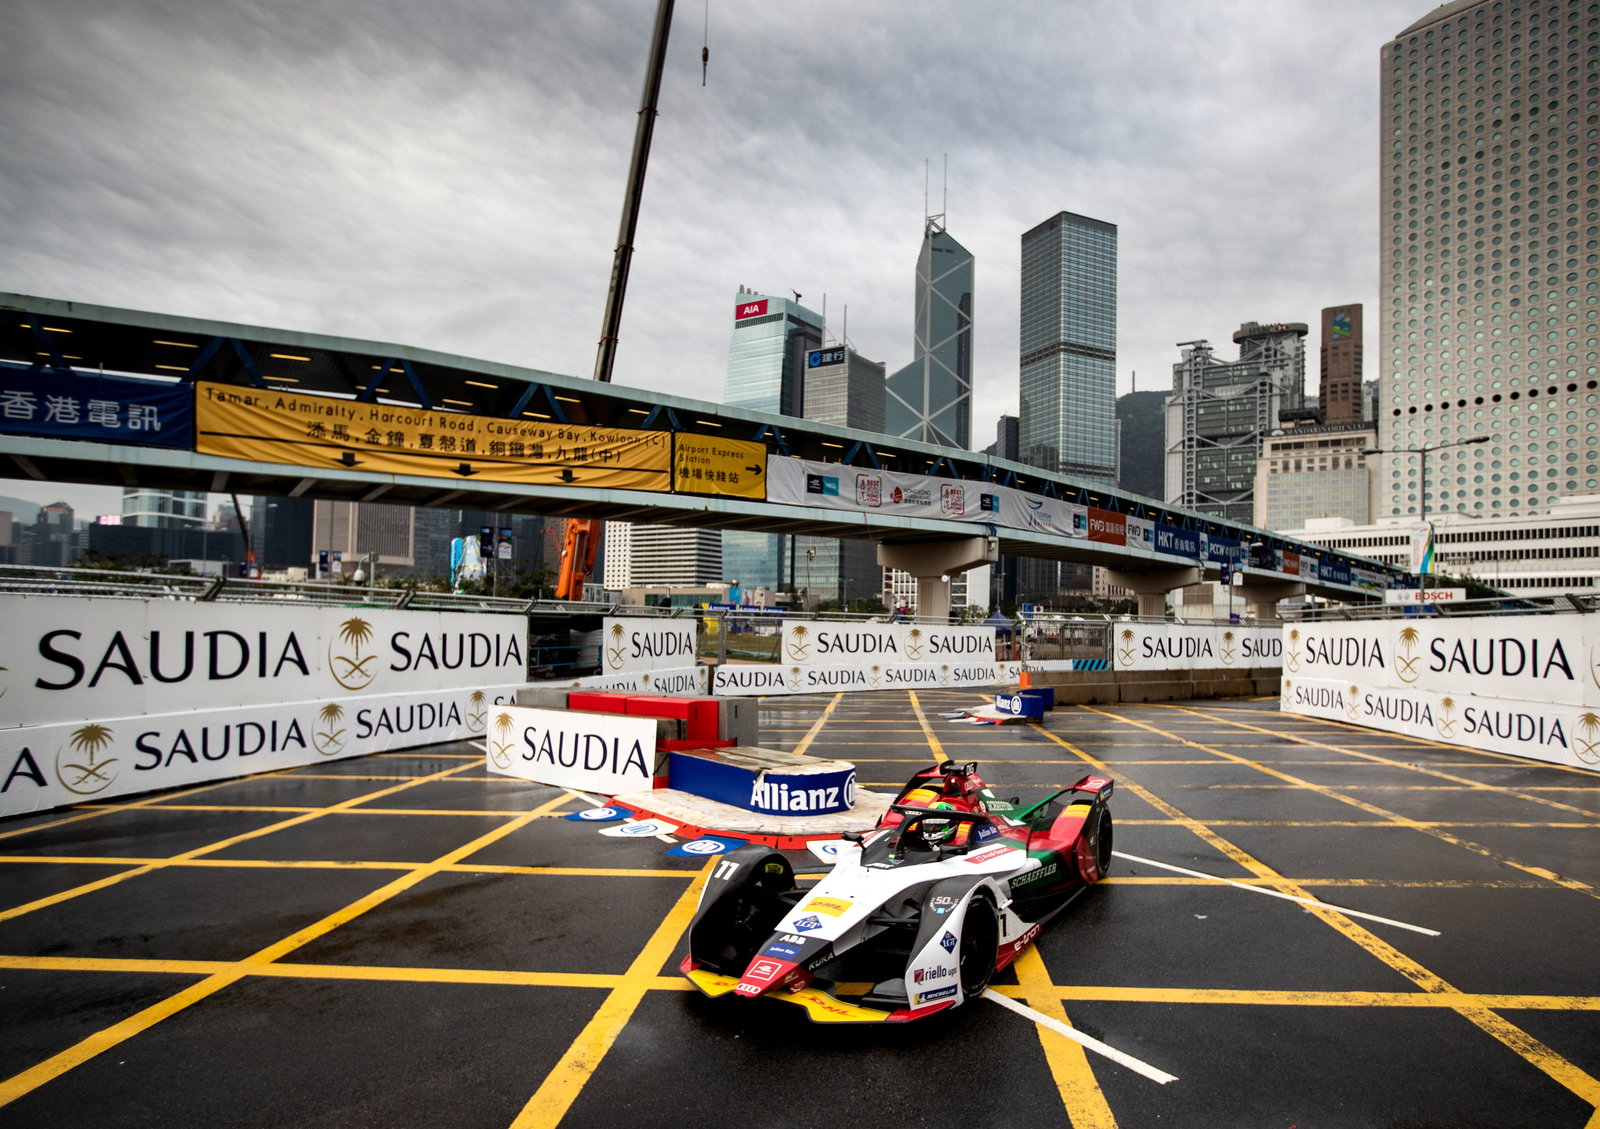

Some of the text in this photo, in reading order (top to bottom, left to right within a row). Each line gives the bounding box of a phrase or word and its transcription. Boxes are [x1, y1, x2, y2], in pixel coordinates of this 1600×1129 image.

[743, 304, 759, 315] AIA
[822, 351, 844, 363] 建行
[0, 390, 161, 431] 香港電訊
[369, 406, 433, 427] Harcourt
[487, 423, 553, 441] Causeway
[590, 431, 640, 445] Kowloon
[679, 444, 744, 459] Airport Express
[679, 454, 711, 464] Station
[1090, 519, 1105, 532] FWD
[1128, 524, 1141, 537] FWD
[1158, 530, 1174, 549] HKT
[1320, 565, 1333, 579] HKT
[631, 631, 693, 658] SAUDIA
[817, 632, 993, 654] SAUDIA SAUDIA
[1142, 636, 1213, 658] SAUDIA
[35, 629, 523, 691] SAUDIA SAUDIA
[1305, 636, 1575, 680] SAUDIA SAUDIA
[654, 674, 695, 693] SAUDIA
[715, 671, 785, 688] SAUDIA
[808, 670, 866, 686] SAUDIA
[885, 668, 937, 682] SAUDIA
[953, 667, 996, 681] SAUDIA
[1295, 685, 1568, 749] SAUDIA SAUDIA SAUDIA
[134, 718, 307, 770] SAUDIA
[356, 701, 462, 739] SAUDIA
[522, 726, 649, 779] SAUDIA
[750, 780, 839, 812] Allianz
[714, 860, 740, 881] 11
[1010, 863, 1057, 889] SCHAEFFLER
[809, 901, 844, 912] DHL
[796, 919, 820, 931] LGT
[779, 934, 807, 945] ABB
[942, 937, 956, 948] LGT
[1014, 923, 1040, 951] e-tron
[808, 952, 834, 971] KUKA
[925, 965, 958, 981] riello ups
[926, 988, 956, 1000] MICHELIN
